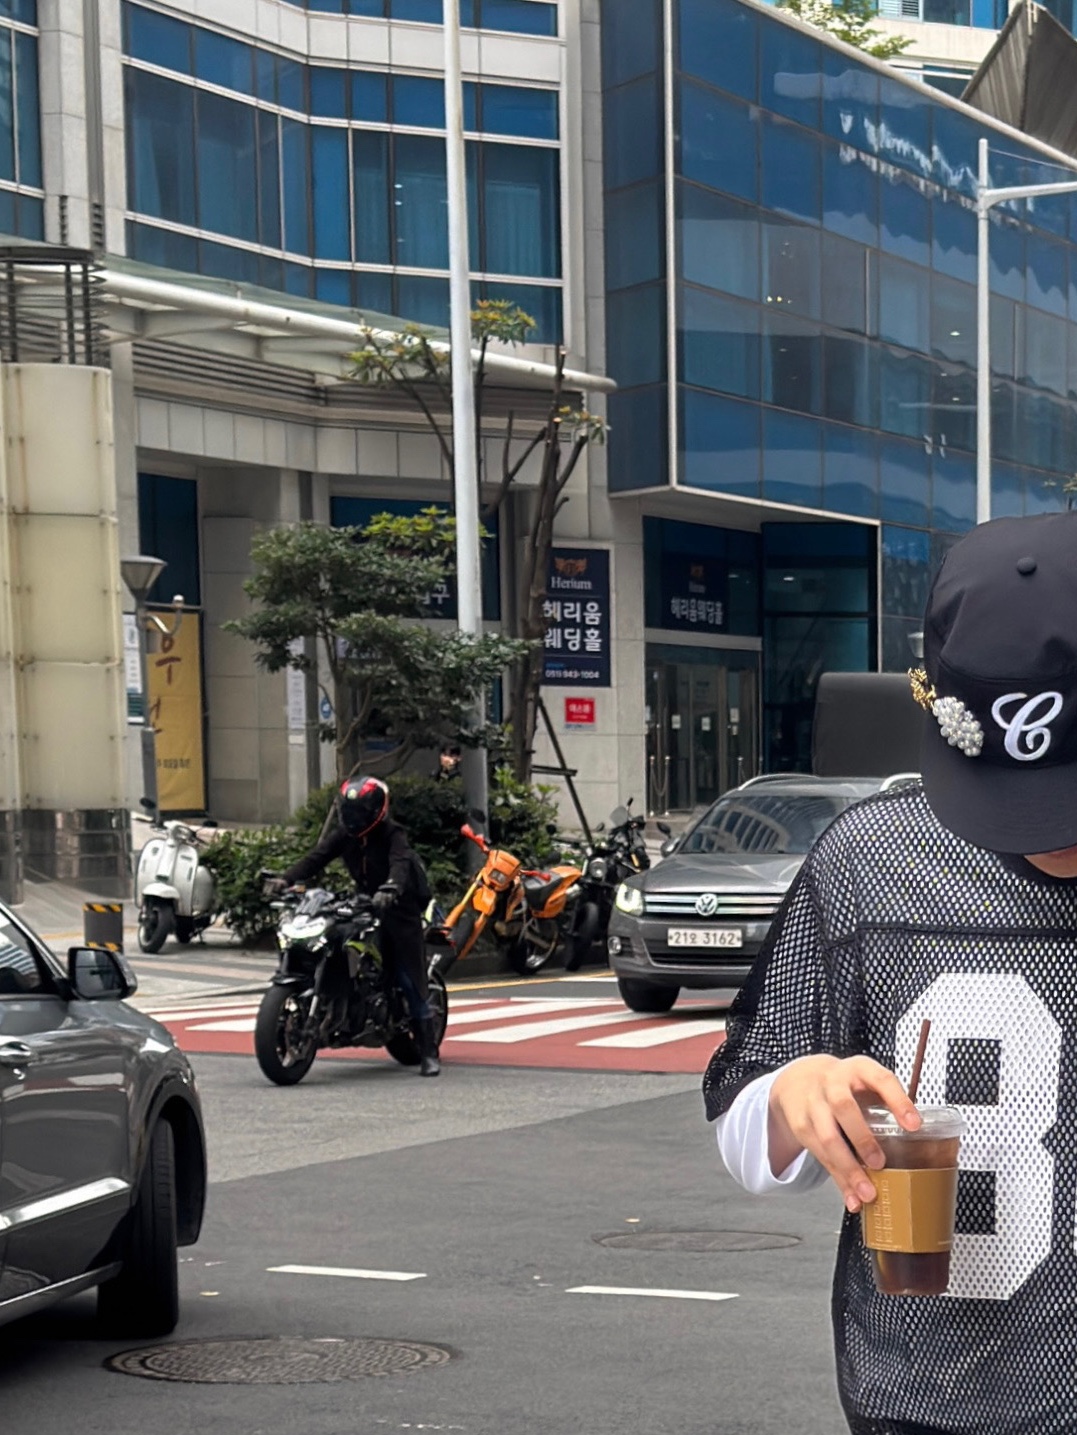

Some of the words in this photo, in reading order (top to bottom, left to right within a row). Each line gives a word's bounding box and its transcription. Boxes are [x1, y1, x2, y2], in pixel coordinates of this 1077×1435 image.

[551, 576, 592, 590] Herium
[542, 600, 602, 625] 헤리움
[544, 628, 602, 651] 웨딩홀
[703, 932, 736, 946] 3162
